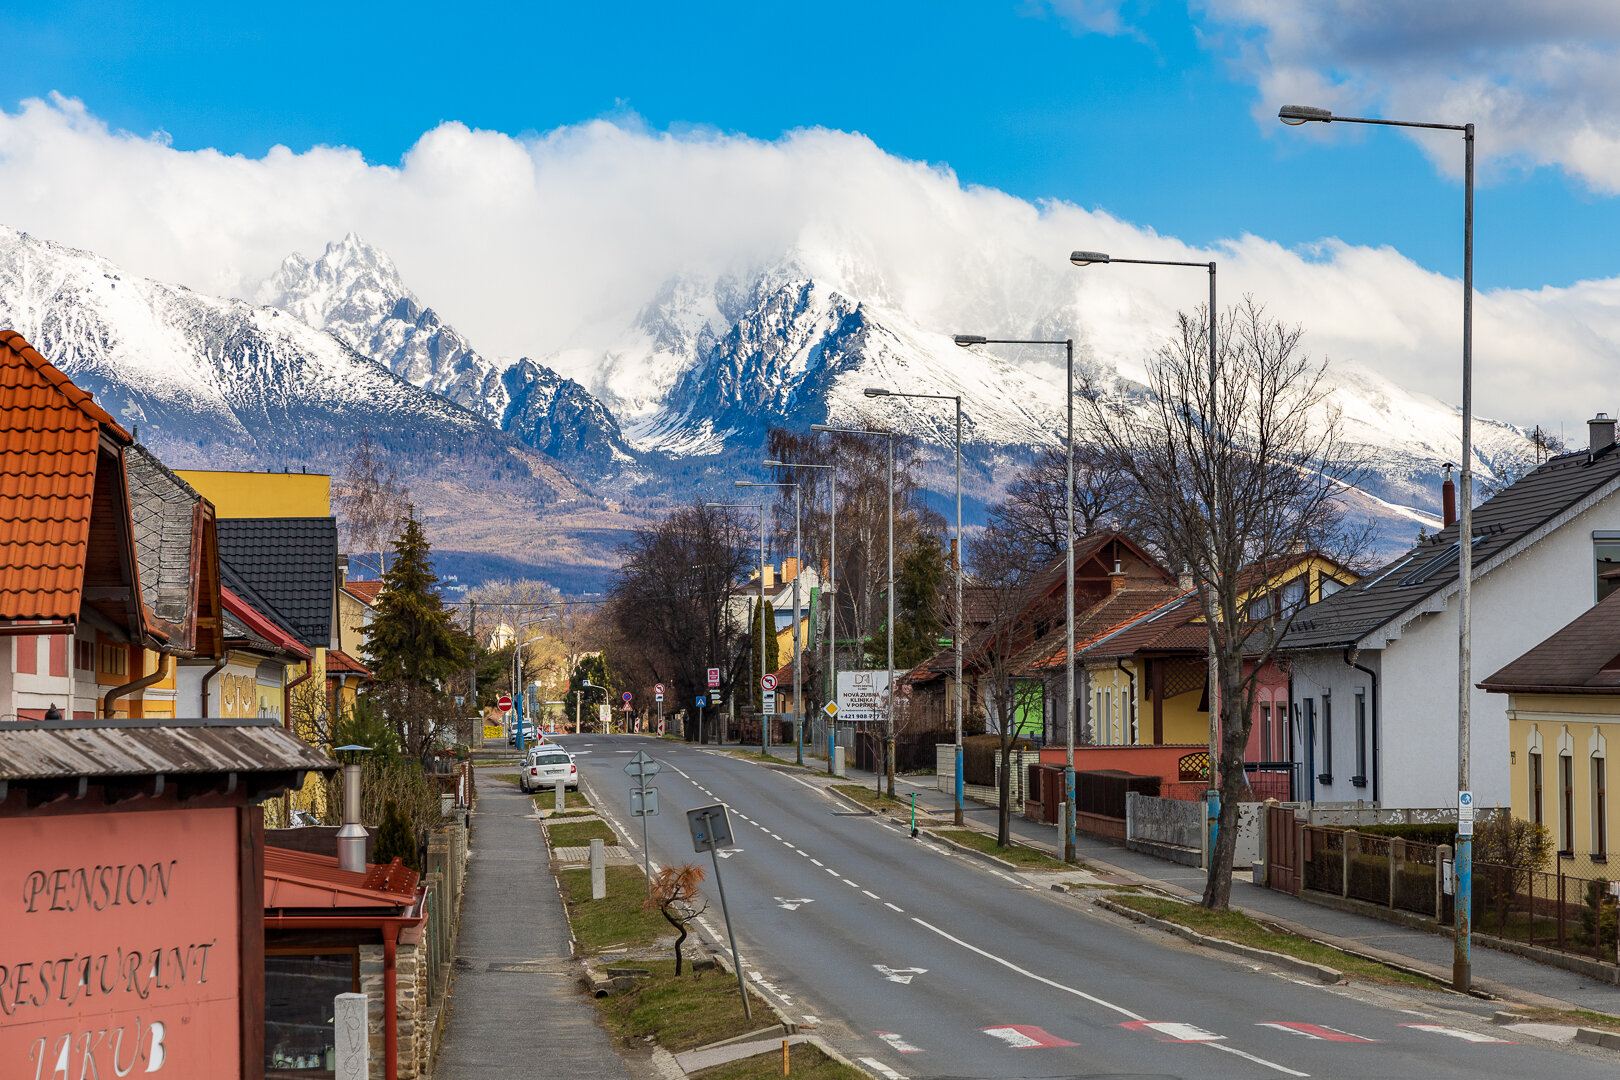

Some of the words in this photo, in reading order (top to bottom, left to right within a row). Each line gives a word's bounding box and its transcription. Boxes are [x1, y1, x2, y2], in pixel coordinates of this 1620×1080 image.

[23, 860, 178, 913] PENSION
[0, 939, 216, 1016] RESTAURANT
[30, 1016, 166, 1080] JAKUB
